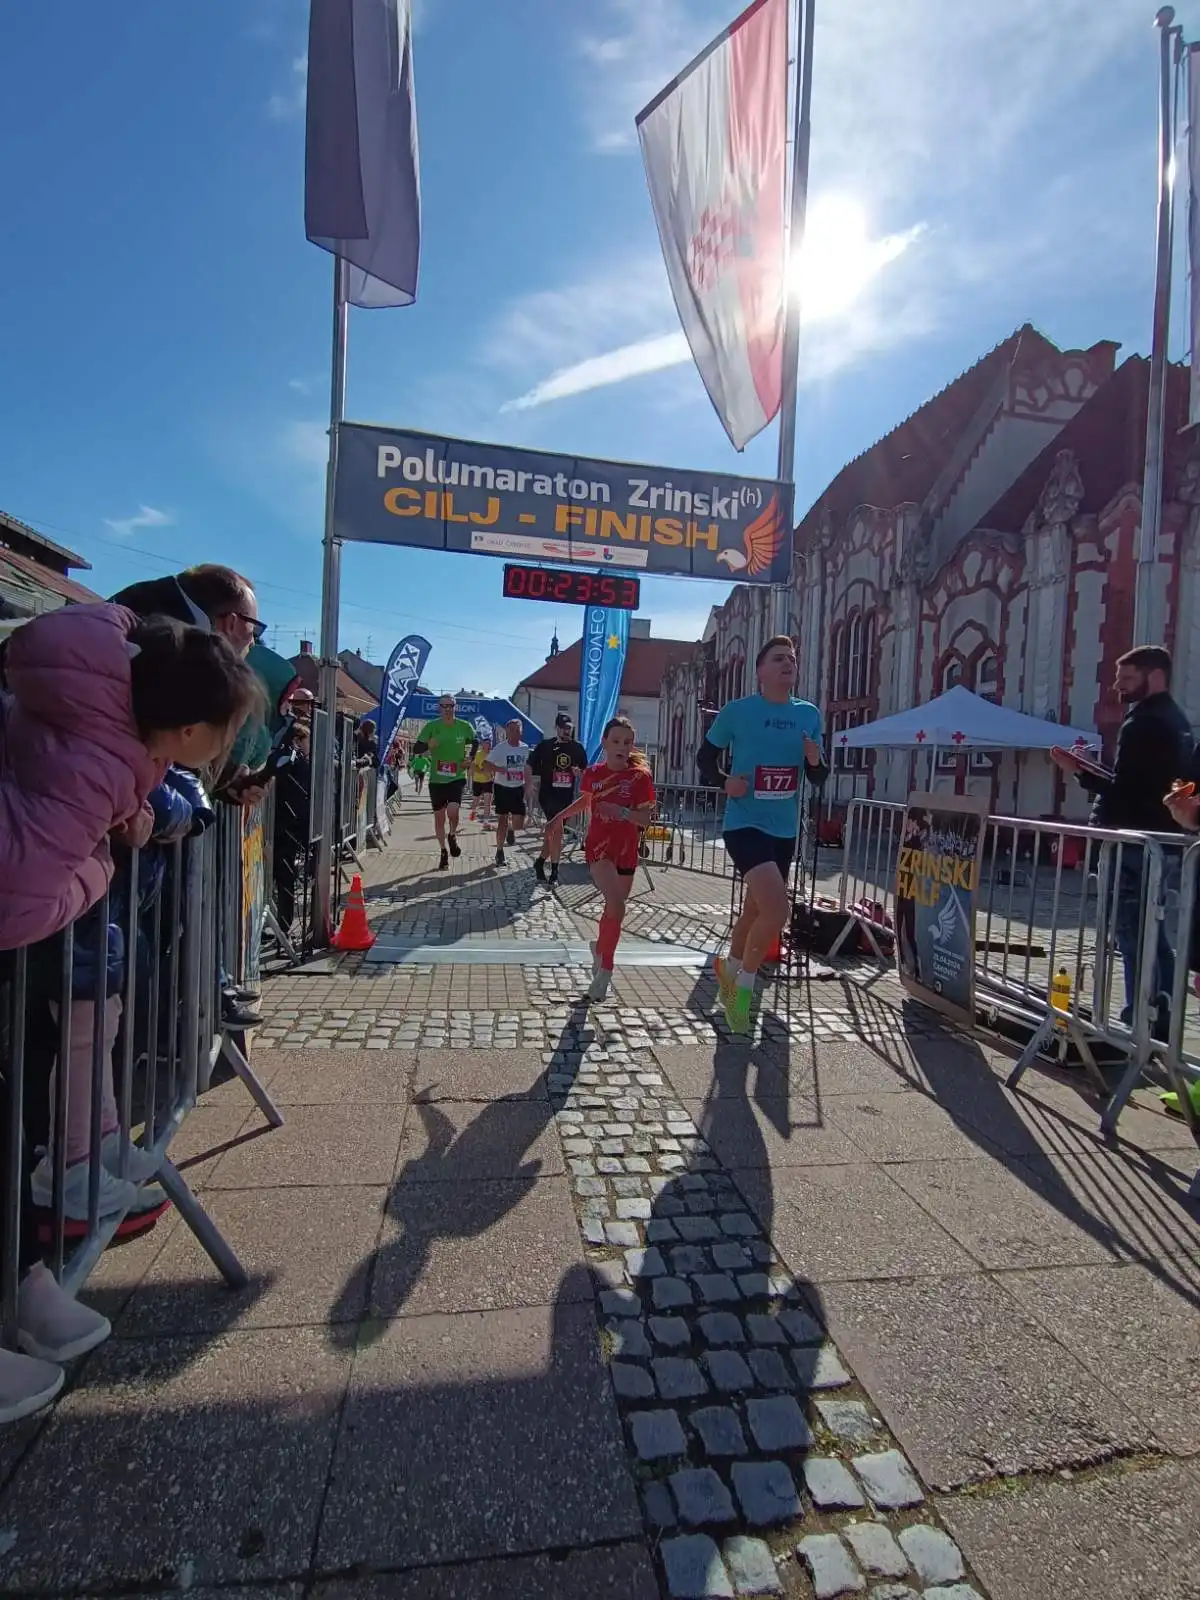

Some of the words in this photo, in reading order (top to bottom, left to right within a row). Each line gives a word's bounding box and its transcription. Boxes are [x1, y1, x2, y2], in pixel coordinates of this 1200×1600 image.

[377, 445, 610, 503] Polumaraton
[383, 487, 501, 525] CILJ
[518, 512, 537, 524] -
[554, 504, 720, 551] FINISH
[507, 567, 638, 606] 00:23:53
[425, 702, 476, 713] DEHLON
[763, 775, 792, 790] 177
[898, 847, 974, 890] ZRINSKI
[896, 870, 940, 907] HALF
